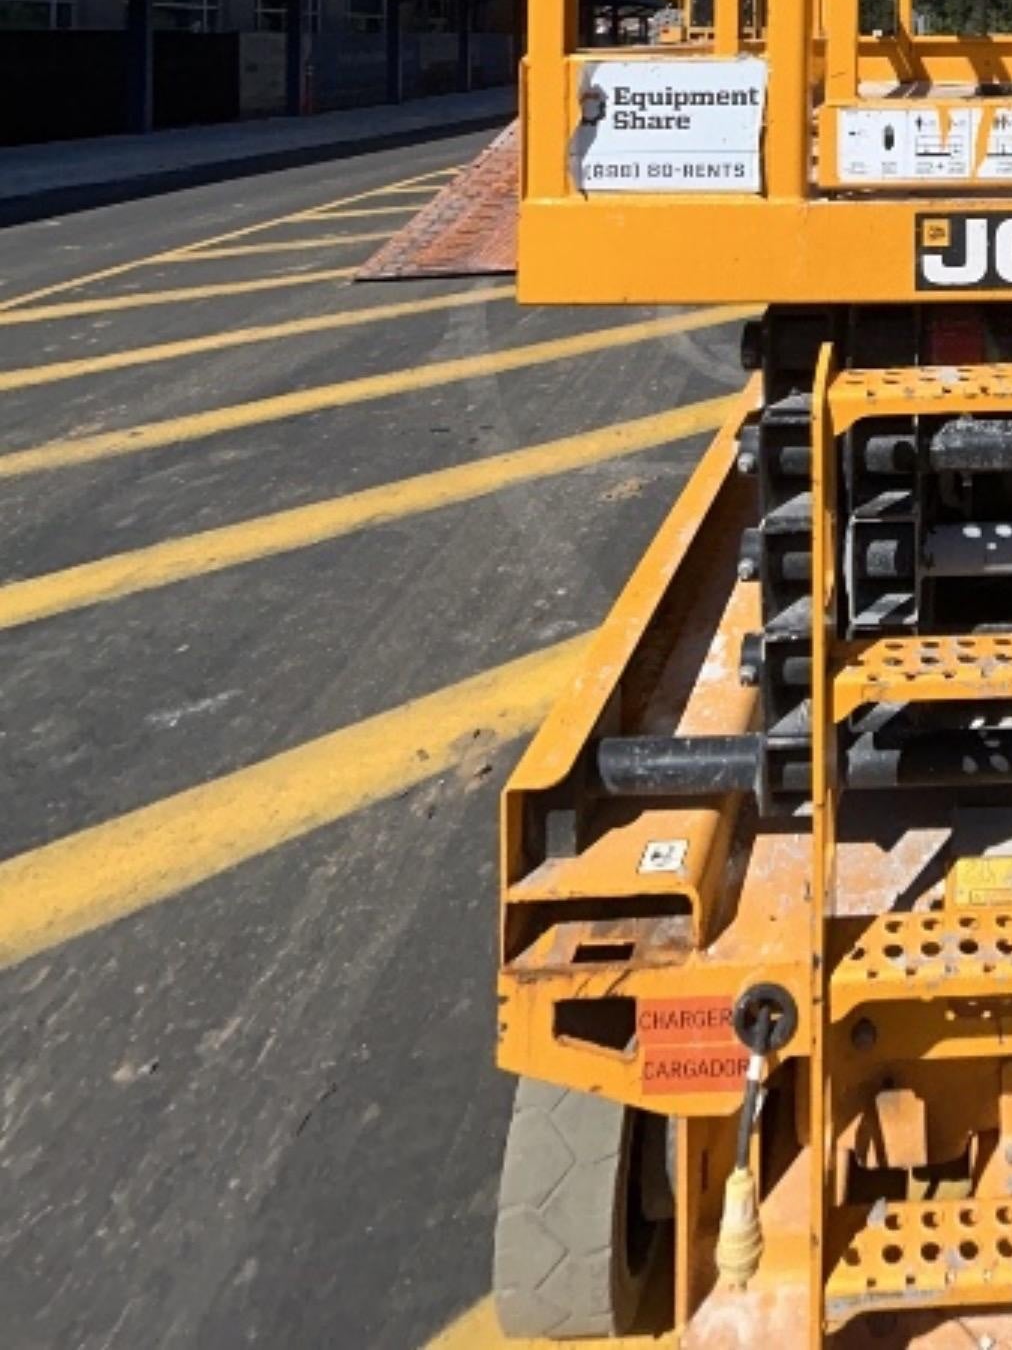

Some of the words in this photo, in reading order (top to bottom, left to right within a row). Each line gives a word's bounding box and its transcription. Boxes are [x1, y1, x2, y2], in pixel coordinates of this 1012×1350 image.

[613, 86, 760, 111] Equipment
[613, 111, 692, 130] Share
[638, 1008, 734, 1030] CHARGER
[643, 1058, 748, 1081] CARGADOR
